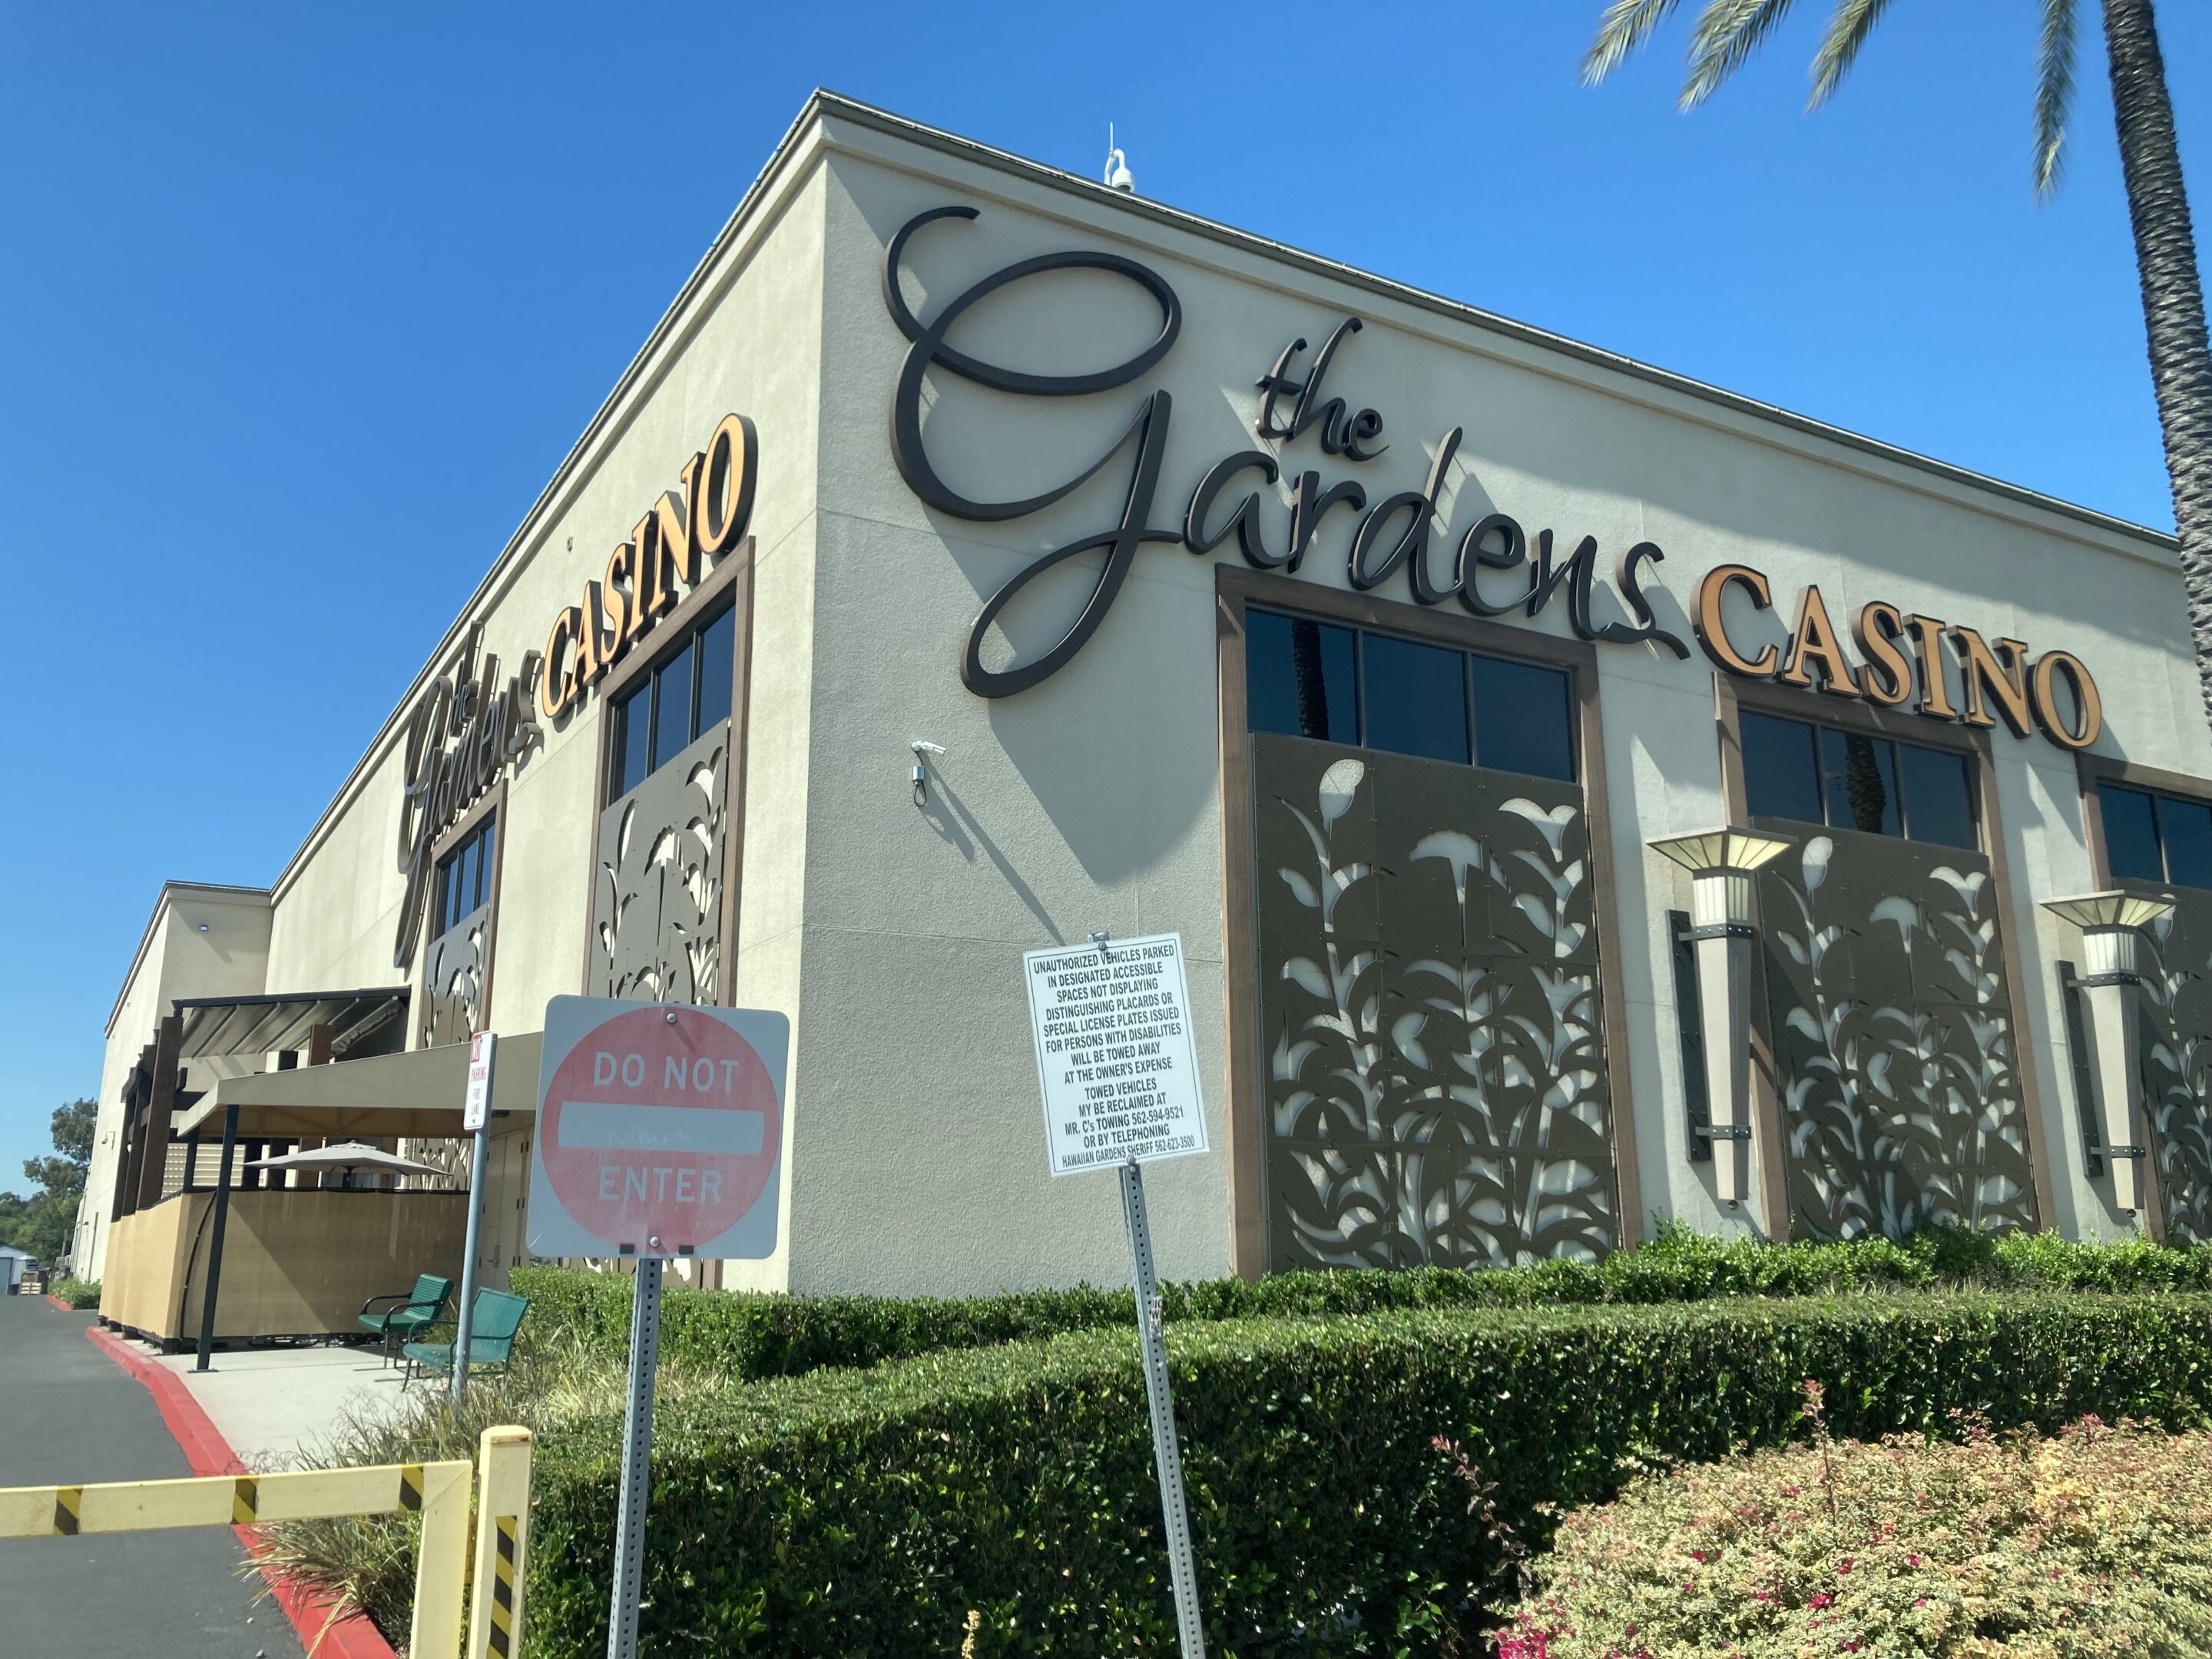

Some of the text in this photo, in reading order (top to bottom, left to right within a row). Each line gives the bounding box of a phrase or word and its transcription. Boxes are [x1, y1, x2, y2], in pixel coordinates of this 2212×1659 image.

[1255, 317, 1389, 461] the
[542, 412, 758, 719] CASINO
[1690, 564, 2102, 750] CASINO
[1034, 944, 1174, 974] UNAUTHORIZED VEHICLES PARKED
[1048, 962, 1163, 988] IN DESIGNATED ACCESSIBLE
[1057, 978, 1158, 1002] SPACES NOT DISPLAYING
[1046, 992, 1173, 1021] DISTINGUISHING PLACARDS OR
[1044, 1007, 1179, 1037] SPECIAL LICENSE PLATES ISSUED
[1046, 1022, 1181, 1053] FOR PERSONS WITH DISABILITIES
[1071, 1041, 1161, 1066] WILL BE TOWED AWAY
[594, 1051, 740, 1093] DO NOT
[1065, 1057, 1173, 1084] AT THE OWNER'S EXPENSE
[1084, 1078, 1157, 1100] TOWED VEHICLES
[1078, 1092, 1166, 1118] MY BE RECLAIMED AT
[1065, 1105, 1184, 1136] MR. C's TOWING 562-594-9521
[1084, 1123, 1170, 1148] OR BY TELEPHONING
[1061, 1134, 1195, 1167] HAWAIIAN GARDENS SHERIFF 562-623-3500
[598, 1165, 723, 1204] ENTER
